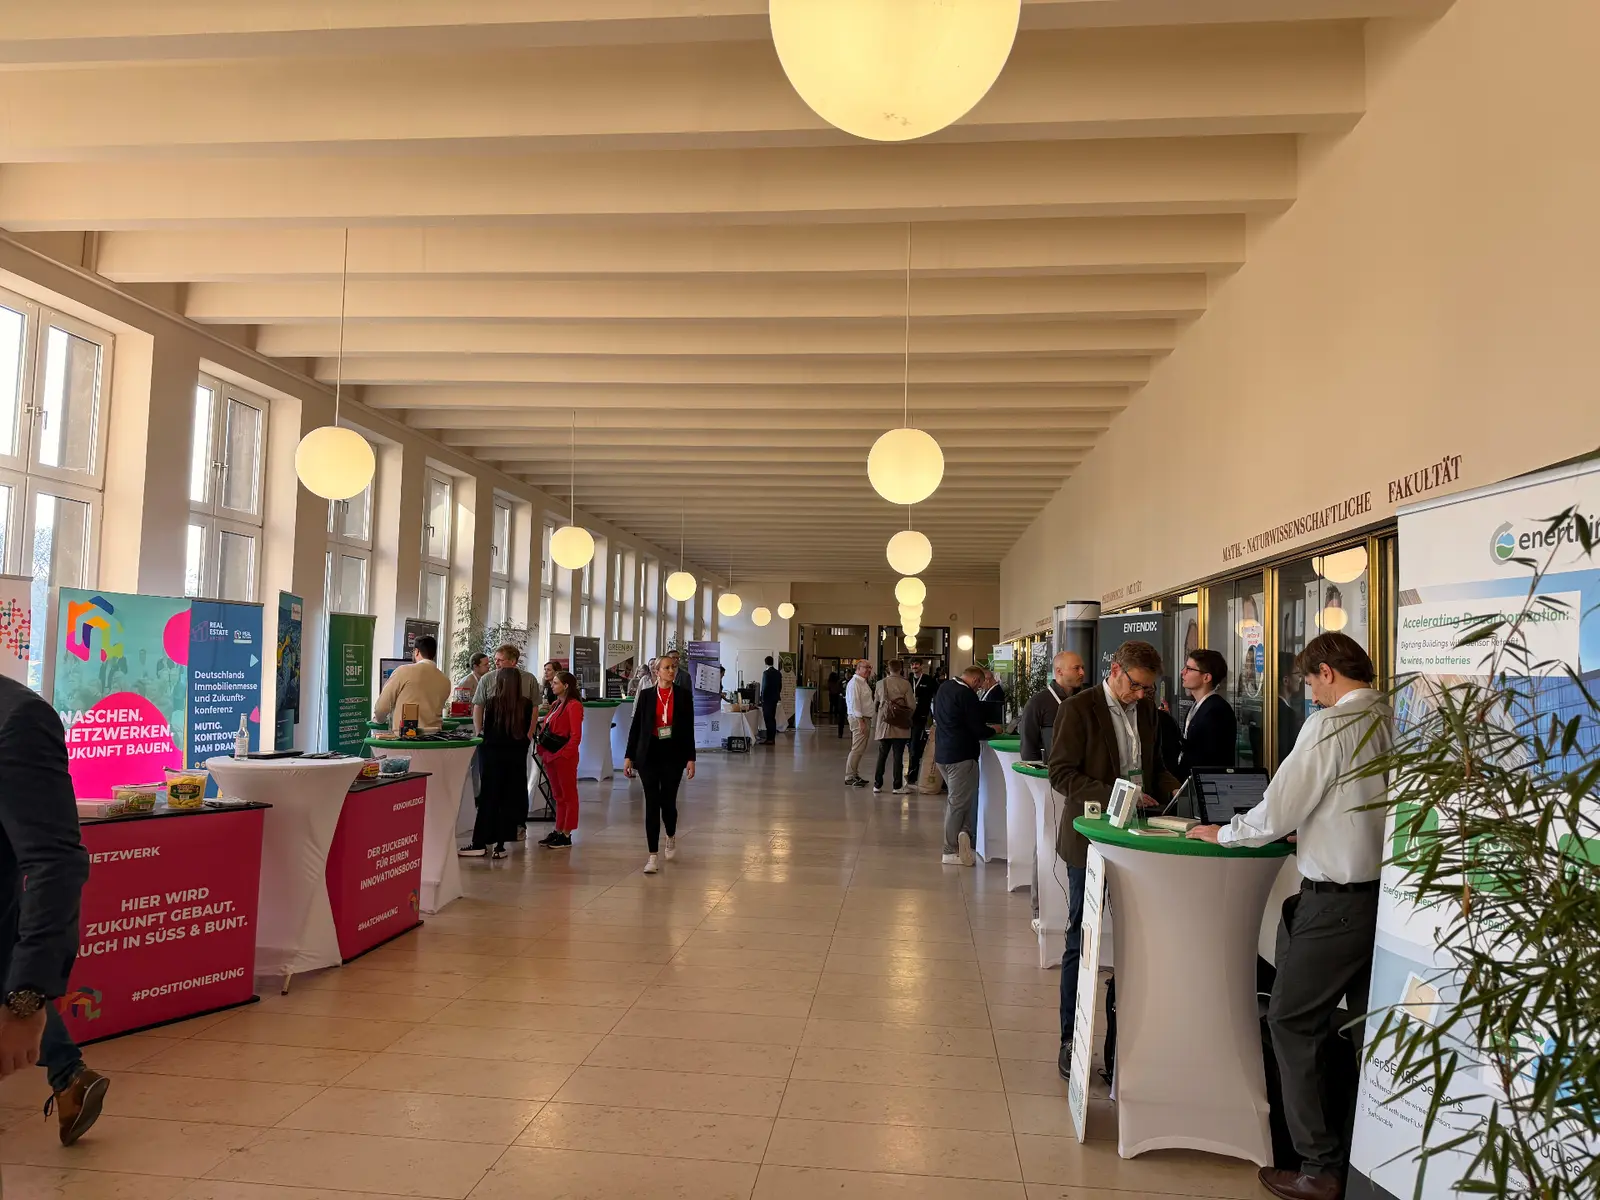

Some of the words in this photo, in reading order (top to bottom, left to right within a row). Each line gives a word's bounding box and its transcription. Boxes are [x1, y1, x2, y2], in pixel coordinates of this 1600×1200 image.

[1388, 455, 1463, 503] FAKULTÄT
[209, 621, 224, 629] REAL
[1123, 621, 1158, 633] ENTENDIX
[1403, 613, 1460, 629] Accelerating
[1422, 639, 1449, 649] Buildings
[1425, 657, 1434, 665] no
[1435, 656, 1471, 665] batteries
[194, 670, 245, 679] Deutschlands
[345, 665, 363, 676] SBIF
[194, 682, 258, 690] Immobilienmesse
[194, 694, 210, 702] und
[212, 693, 246, 702] Zukunfts-
[60, 708, 143, 725] NASCHEN.
[194, 706, 233, 714] konferenz
[194, 722, 222, 731] MUTIG.
[194, 732, 237, 742] KONTROVE
[68, 745, 123, 760] UKUNFT
[126, 742, 173, 755] BAUEN.
[194, 744, 212, 753] NAH
[367, 846, 381, 859] DER
[381, 833, 418, 854] ZUCKERKICK
[375, 856, 388, 870] FÜR
[389, 849, 409, 865] EUREN
[360, 858, 421, 891] INNOVATIONSBOOST
[121, 894, 160, 912] HIER
[165, 887, 209, 905] WIRD
[1404, 891, 1442, 912] Effiency
[85, 911, 167, 938] ZUKUNFT
[170, 900, 236, 922] GEBAUT.
[357, 906, 399, 932] #MATCHMAKING
[76, 938, 118, 959] UCH
[123, 935, 140, 950] IN
[145, 926, 186, 945] SÜSS
[190, 924, 201, 936] &
[204, 915, 249, 934] BUNT.
[131, 967, 245, 1002] #POSITIONIERUNG
[1420, 1084, 1463, 1113] Sesors
